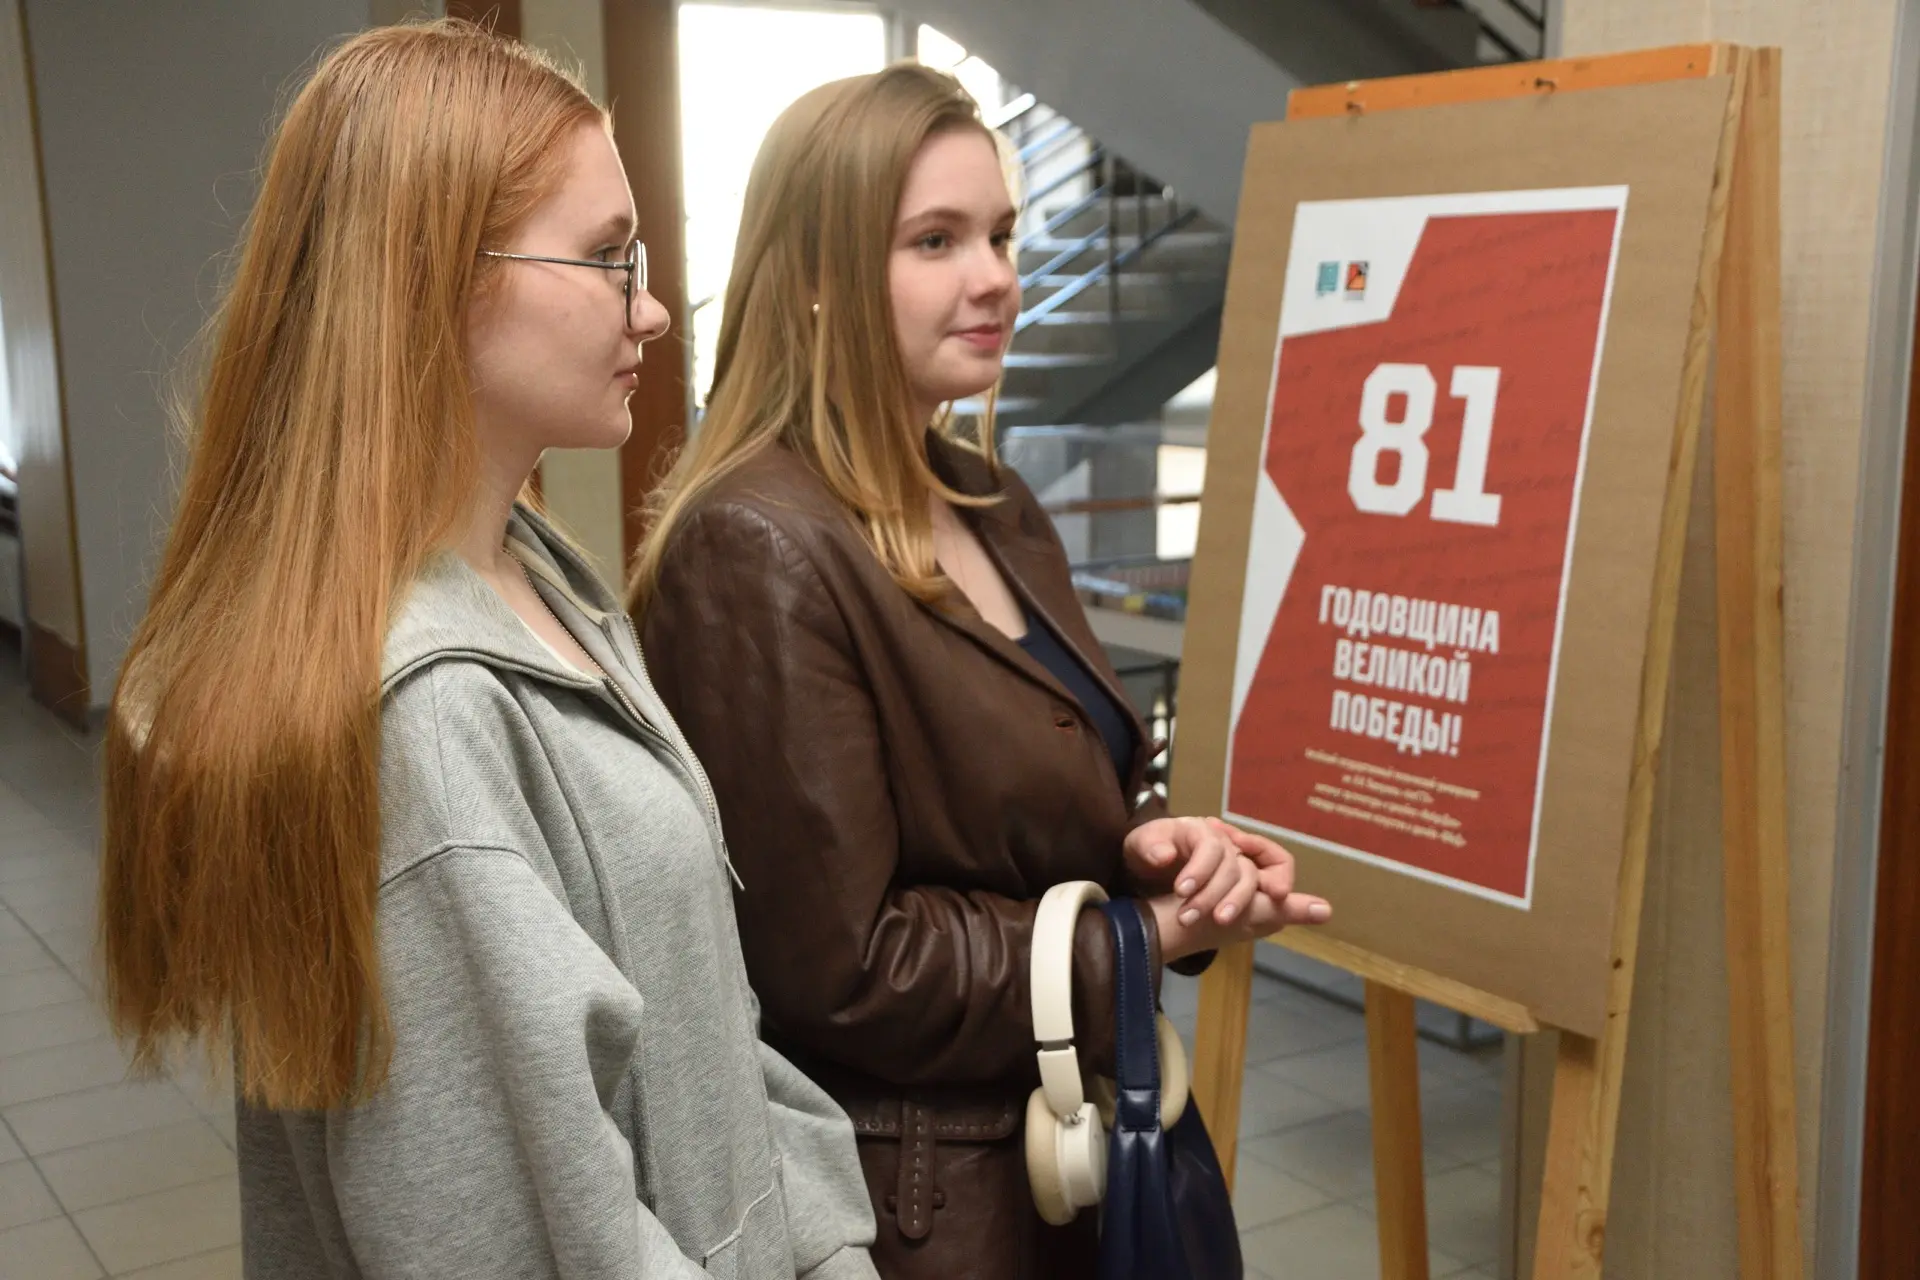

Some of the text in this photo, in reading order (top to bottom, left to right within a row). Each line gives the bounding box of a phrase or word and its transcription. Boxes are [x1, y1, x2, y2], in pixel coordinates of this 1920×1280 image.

[1347, 362, 1502, 526] 81
[1319, 584, 1500, 655] ГОДОВЩИНА
[1333, 638, 1471, 704] ВЕЛИКОЙ
[1330, 690, 1462, 757] ПОБЕДЫ!
